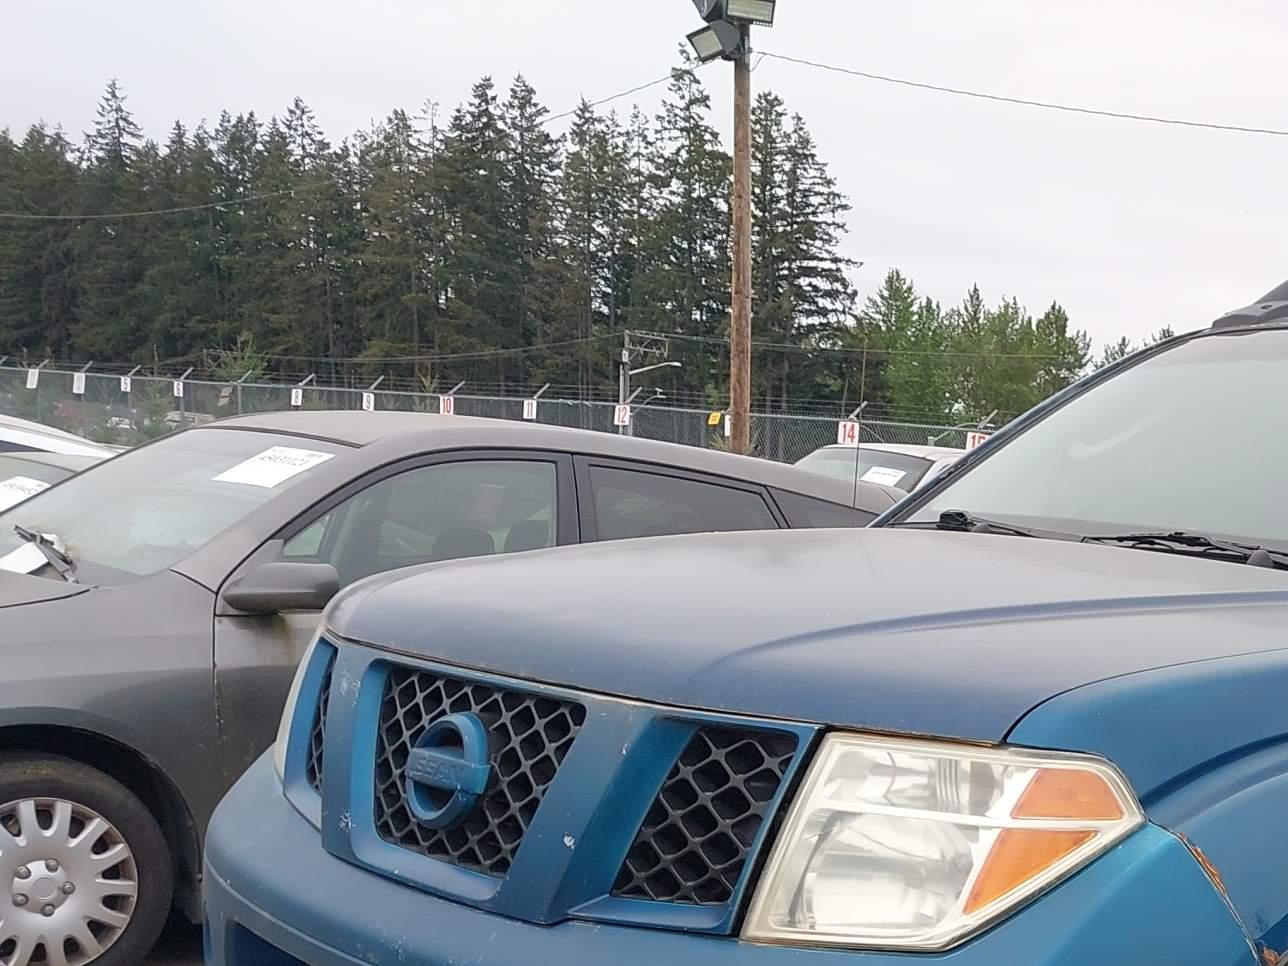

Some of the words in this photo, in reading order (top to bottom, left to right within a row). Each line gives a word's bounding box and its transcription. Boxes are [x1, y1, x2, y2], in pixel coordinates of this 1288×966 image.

[441, 397, 452, 414] 10
[616, 406, 628, 424] 12
[842, 423, 856, 443] 14
